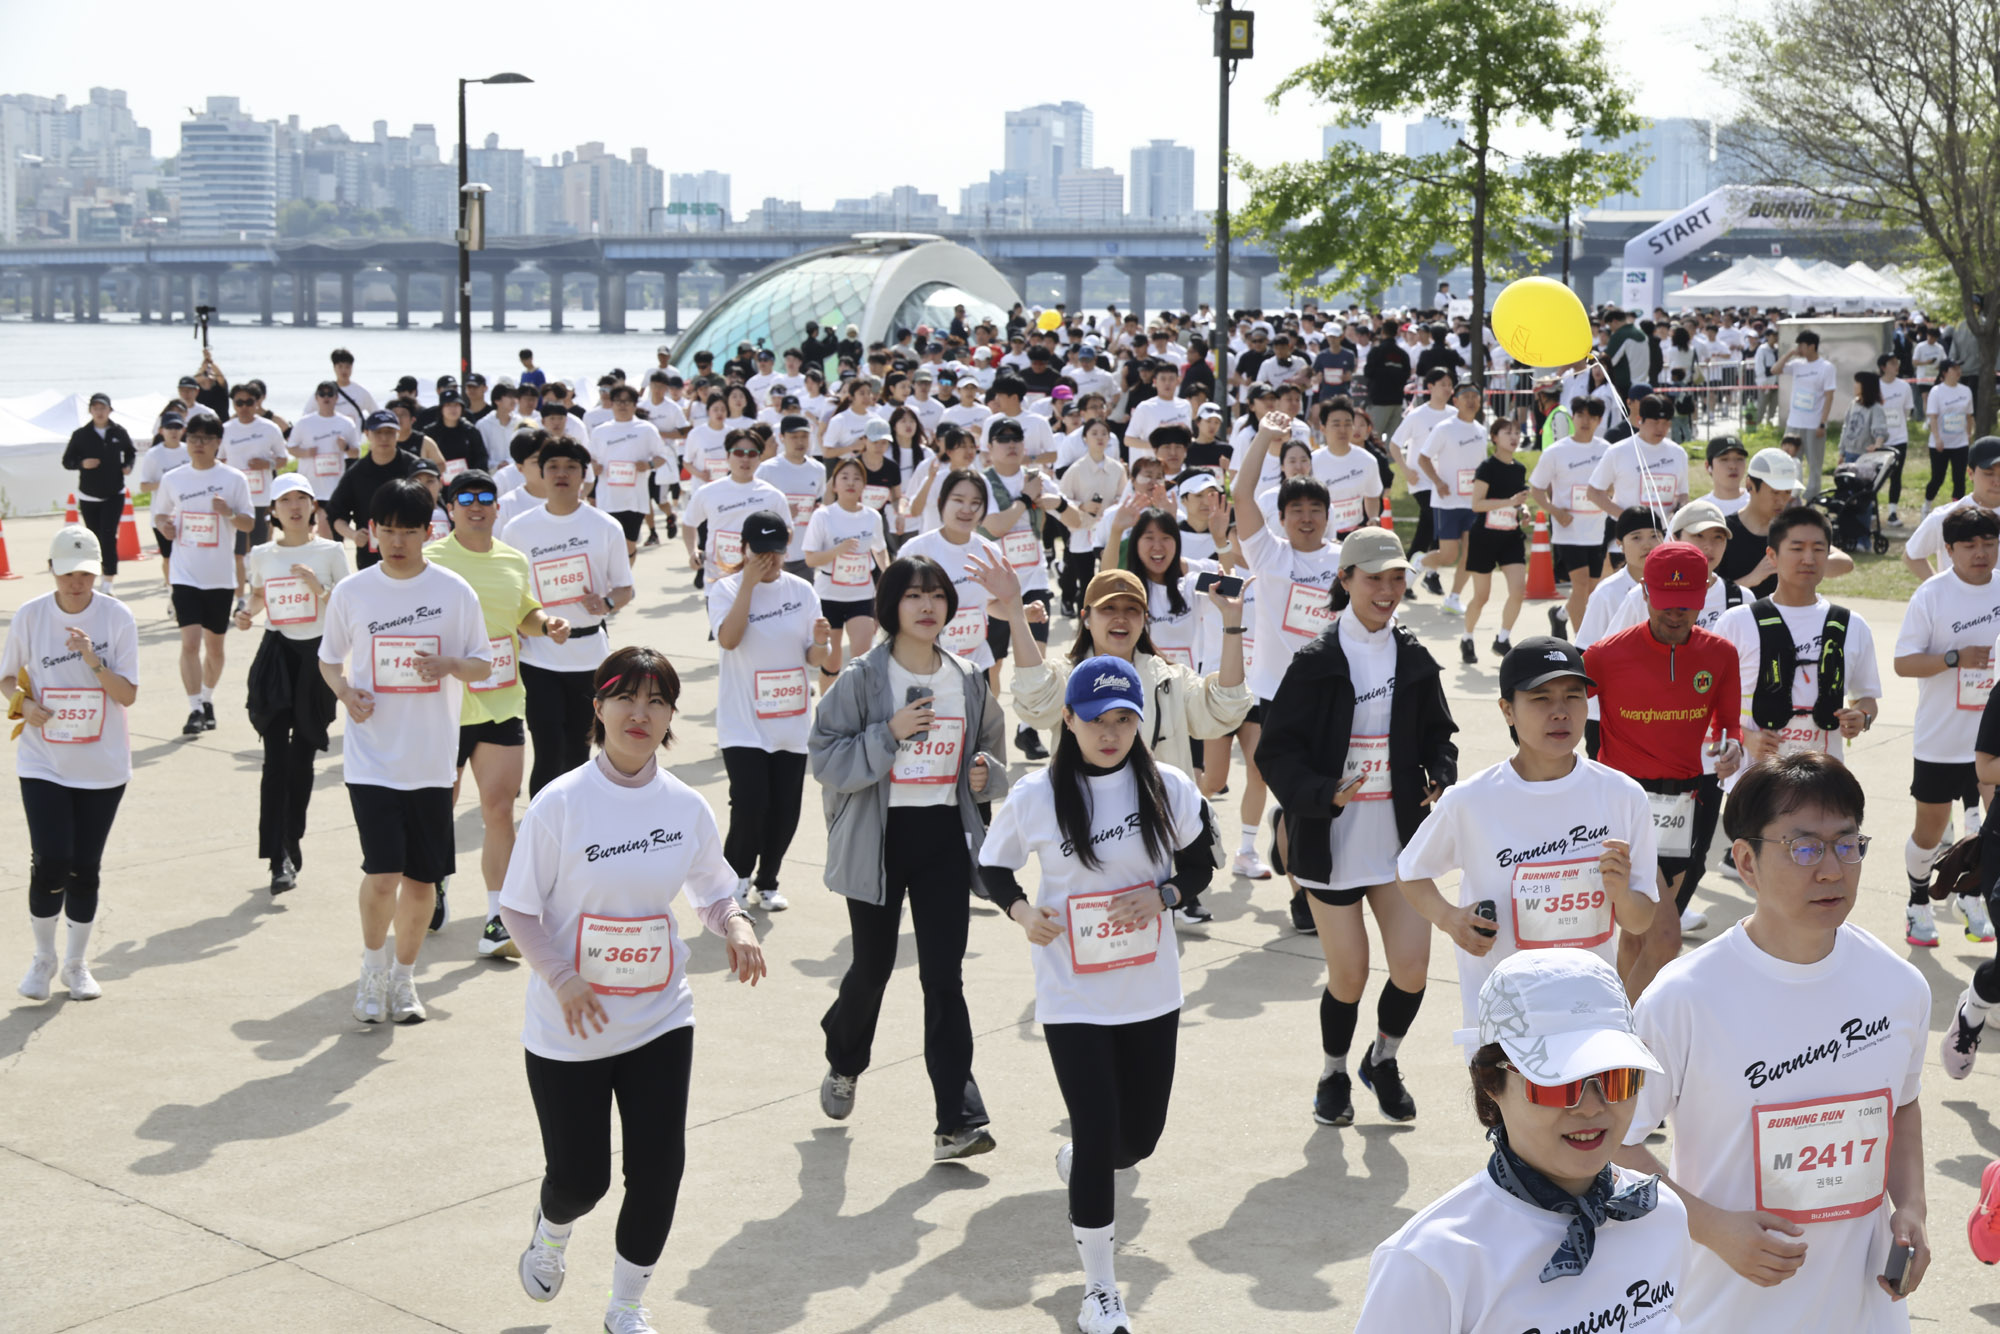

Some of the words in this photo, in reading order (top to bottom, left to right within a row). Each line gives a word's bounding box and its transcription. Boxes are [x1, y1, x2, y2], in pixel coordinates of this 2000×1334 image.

[1648, 206, 1712, 255] START
[531, 542, 567, 558] Burning
[567, 537, 589, 549] Run
[553, 571, 585, 587] 1685
[278, 592, 311, 606] 3184
[368, 614, 415, 635] Burning
[415, 605, 443, 621] Run
[748, 607, 783, 623] Burning
[781, 602, 802, 612] Run
[1304, 604, 1337, 621] 1635
[948, 623, 981, 637] 3417
[1952, 611, 1992, 634] Burning
[41, 650, 83, 669] Burning
[381, 658, 390, 666] M
[772, 685, 803, 698] 3095
[1354, 685, 1388, 705] urning
[57, 709, 98, 721] 3537
[1782, 728, 1821, 742] 2291
[900, 743, 913, 752] W
[914, 741, 956, 755] 3103
[1347, 760, 1359, 771] W
[585, 843, 650, 863] Burning
[650, 829, 683, 845] Run
[1060, 825, 1126, 858] Bning
[1496, 838, 1569, 868] Burning
[1569, 825, 1610, 847] Run
[1522, 870, 1561, 880] BURNING
[1562, 868, 1580, 878] RUN
[1520, 884, 1551, 894] A-218
[1075, 900, 1109, 911] BURNING
[1525, 898, 1541, 911] W
[1544, 890, 1605, 913] 3559
[588, 923, 624, 934] BURNING
[1080, 925, 1093, 938] W
[588, 947, 602, 958] W
[604, 946, 662, 963] 3667
[1744, 1039, 1842, 1089] Burning
[1840, 1016, 1891, 1048] Run
[1767, 1113, 1818, 1129] BURNING
[1820, 1109, 1846, 1121] RUN
[1858, 1106, 1882, 1117] 10km
[1773, 1153, 1793, 1170] M
[1797, 1137, 1879, 1172] 2417
[1626, 1279, 1674, 1317] Run
[1628, 1318, 1647, 1329] Casual
[1645, 1306, 1667, 1320] Running
